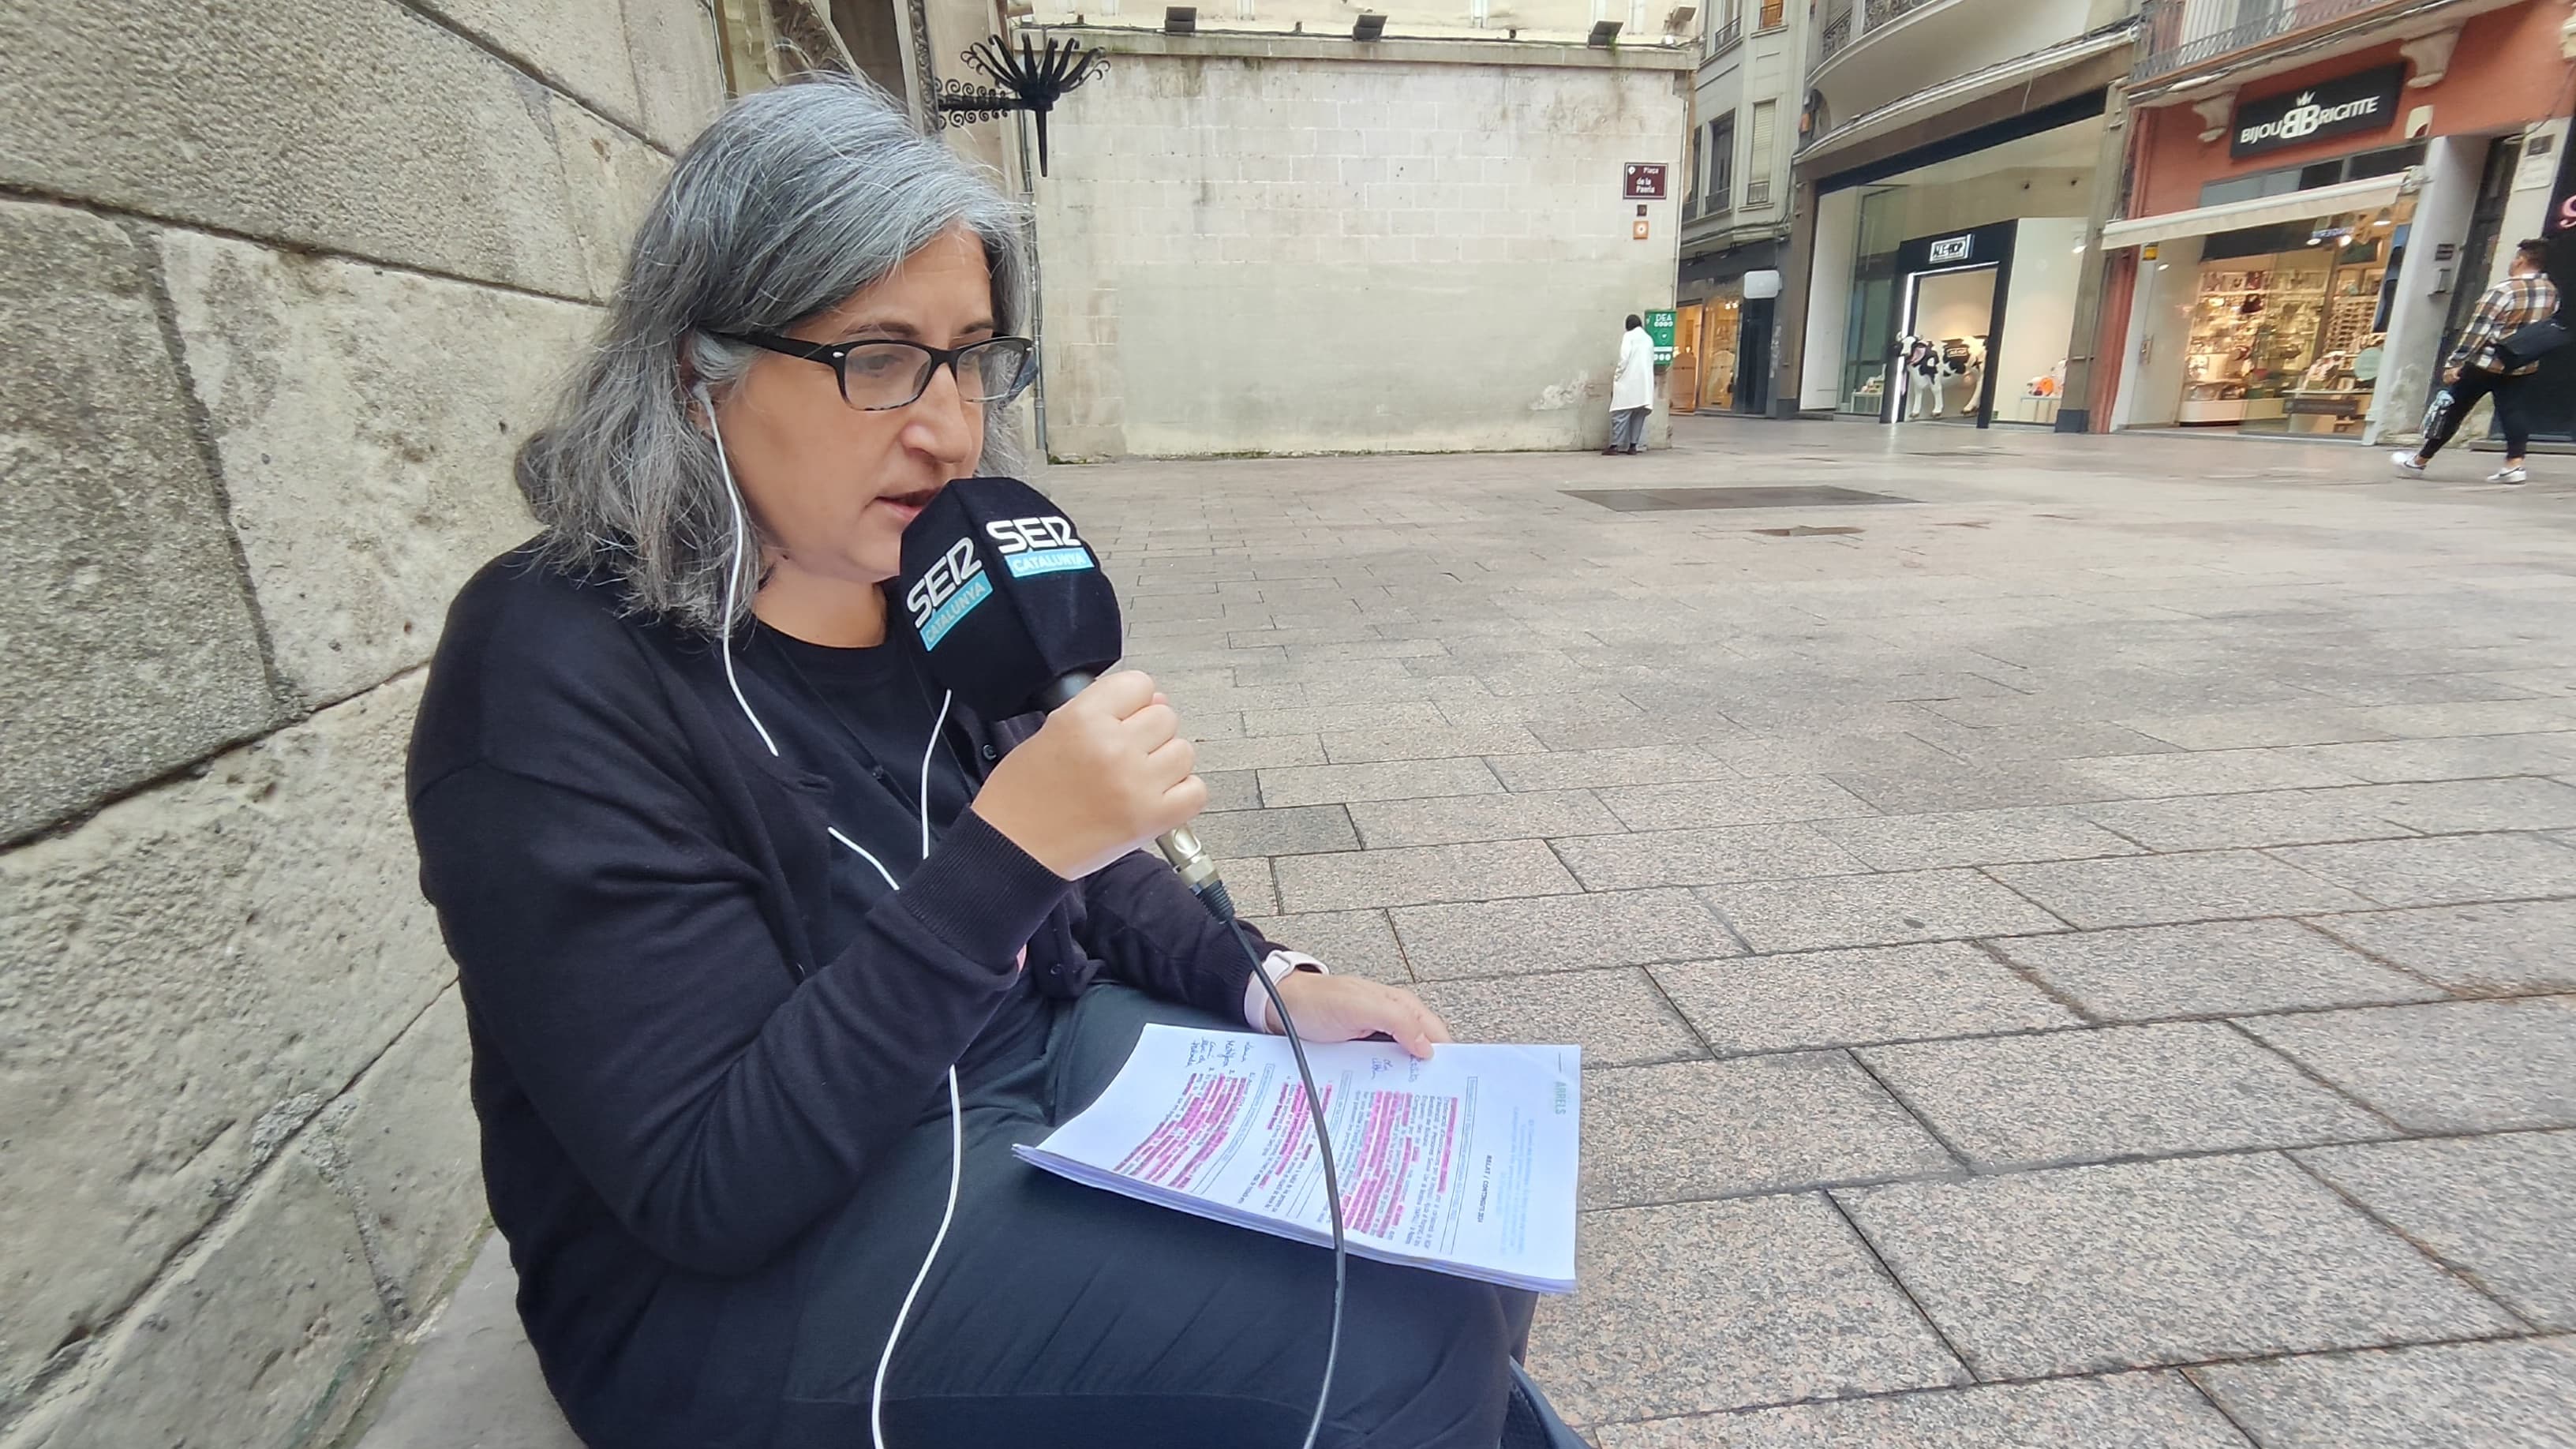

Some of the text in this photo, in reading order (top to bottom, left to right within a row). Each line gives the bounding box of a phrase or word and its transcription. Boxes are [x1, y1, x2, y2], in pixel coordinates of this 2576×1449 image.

[2240, 120, 2283, 144] BIJOU
[1636, 177, 1645, 185] de
[986, 516, 1081, 554] SER
[1012, 554, 1088, 573] CATALUNYA
[907, 537, 983, 629] SER
[925, 583, 986, 642] CATALUNYA
[1554, 1081, 1567, 1115] ARRELS
